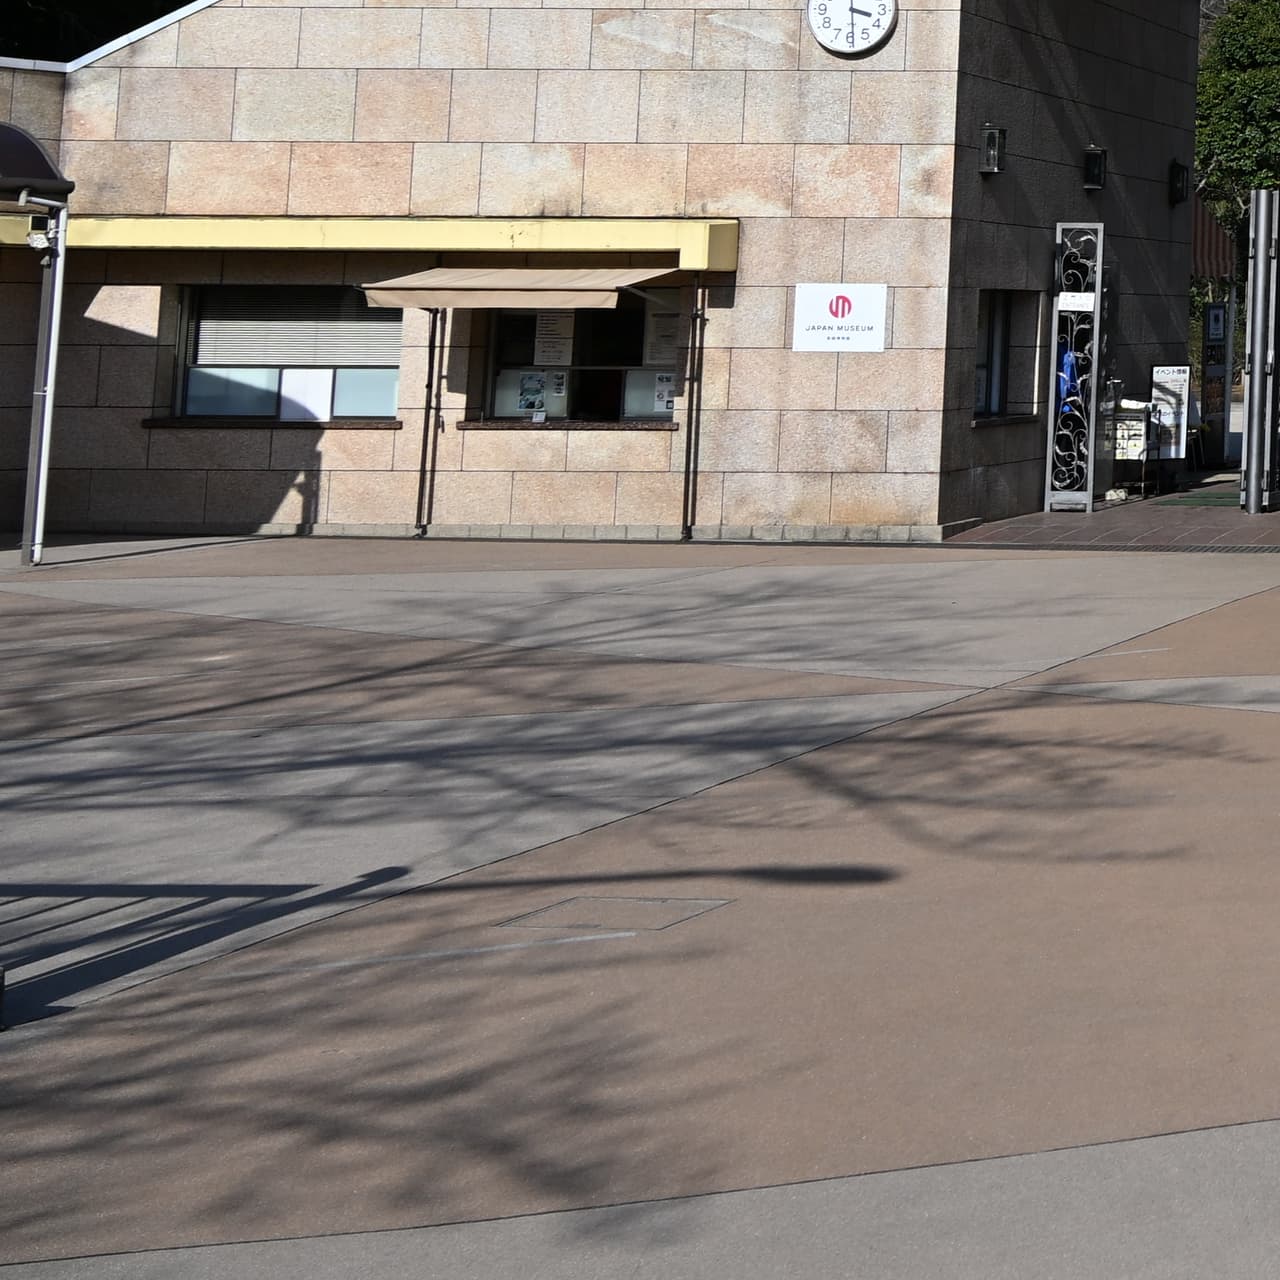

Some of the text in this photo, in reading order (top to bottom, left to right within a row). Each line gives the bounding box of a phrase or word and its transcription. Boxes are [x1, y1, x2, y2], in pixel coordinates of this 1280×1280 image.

[818, 3, 827, 16] 9
[877, 3, 887, 16] 3
[822, 16, 831, 29] 8
[872, 18, 881, 29] 4
[833, 28, 842, 40] 7
[846, 31, 855, 44] 6
[860, 28, 870, 40] 5
